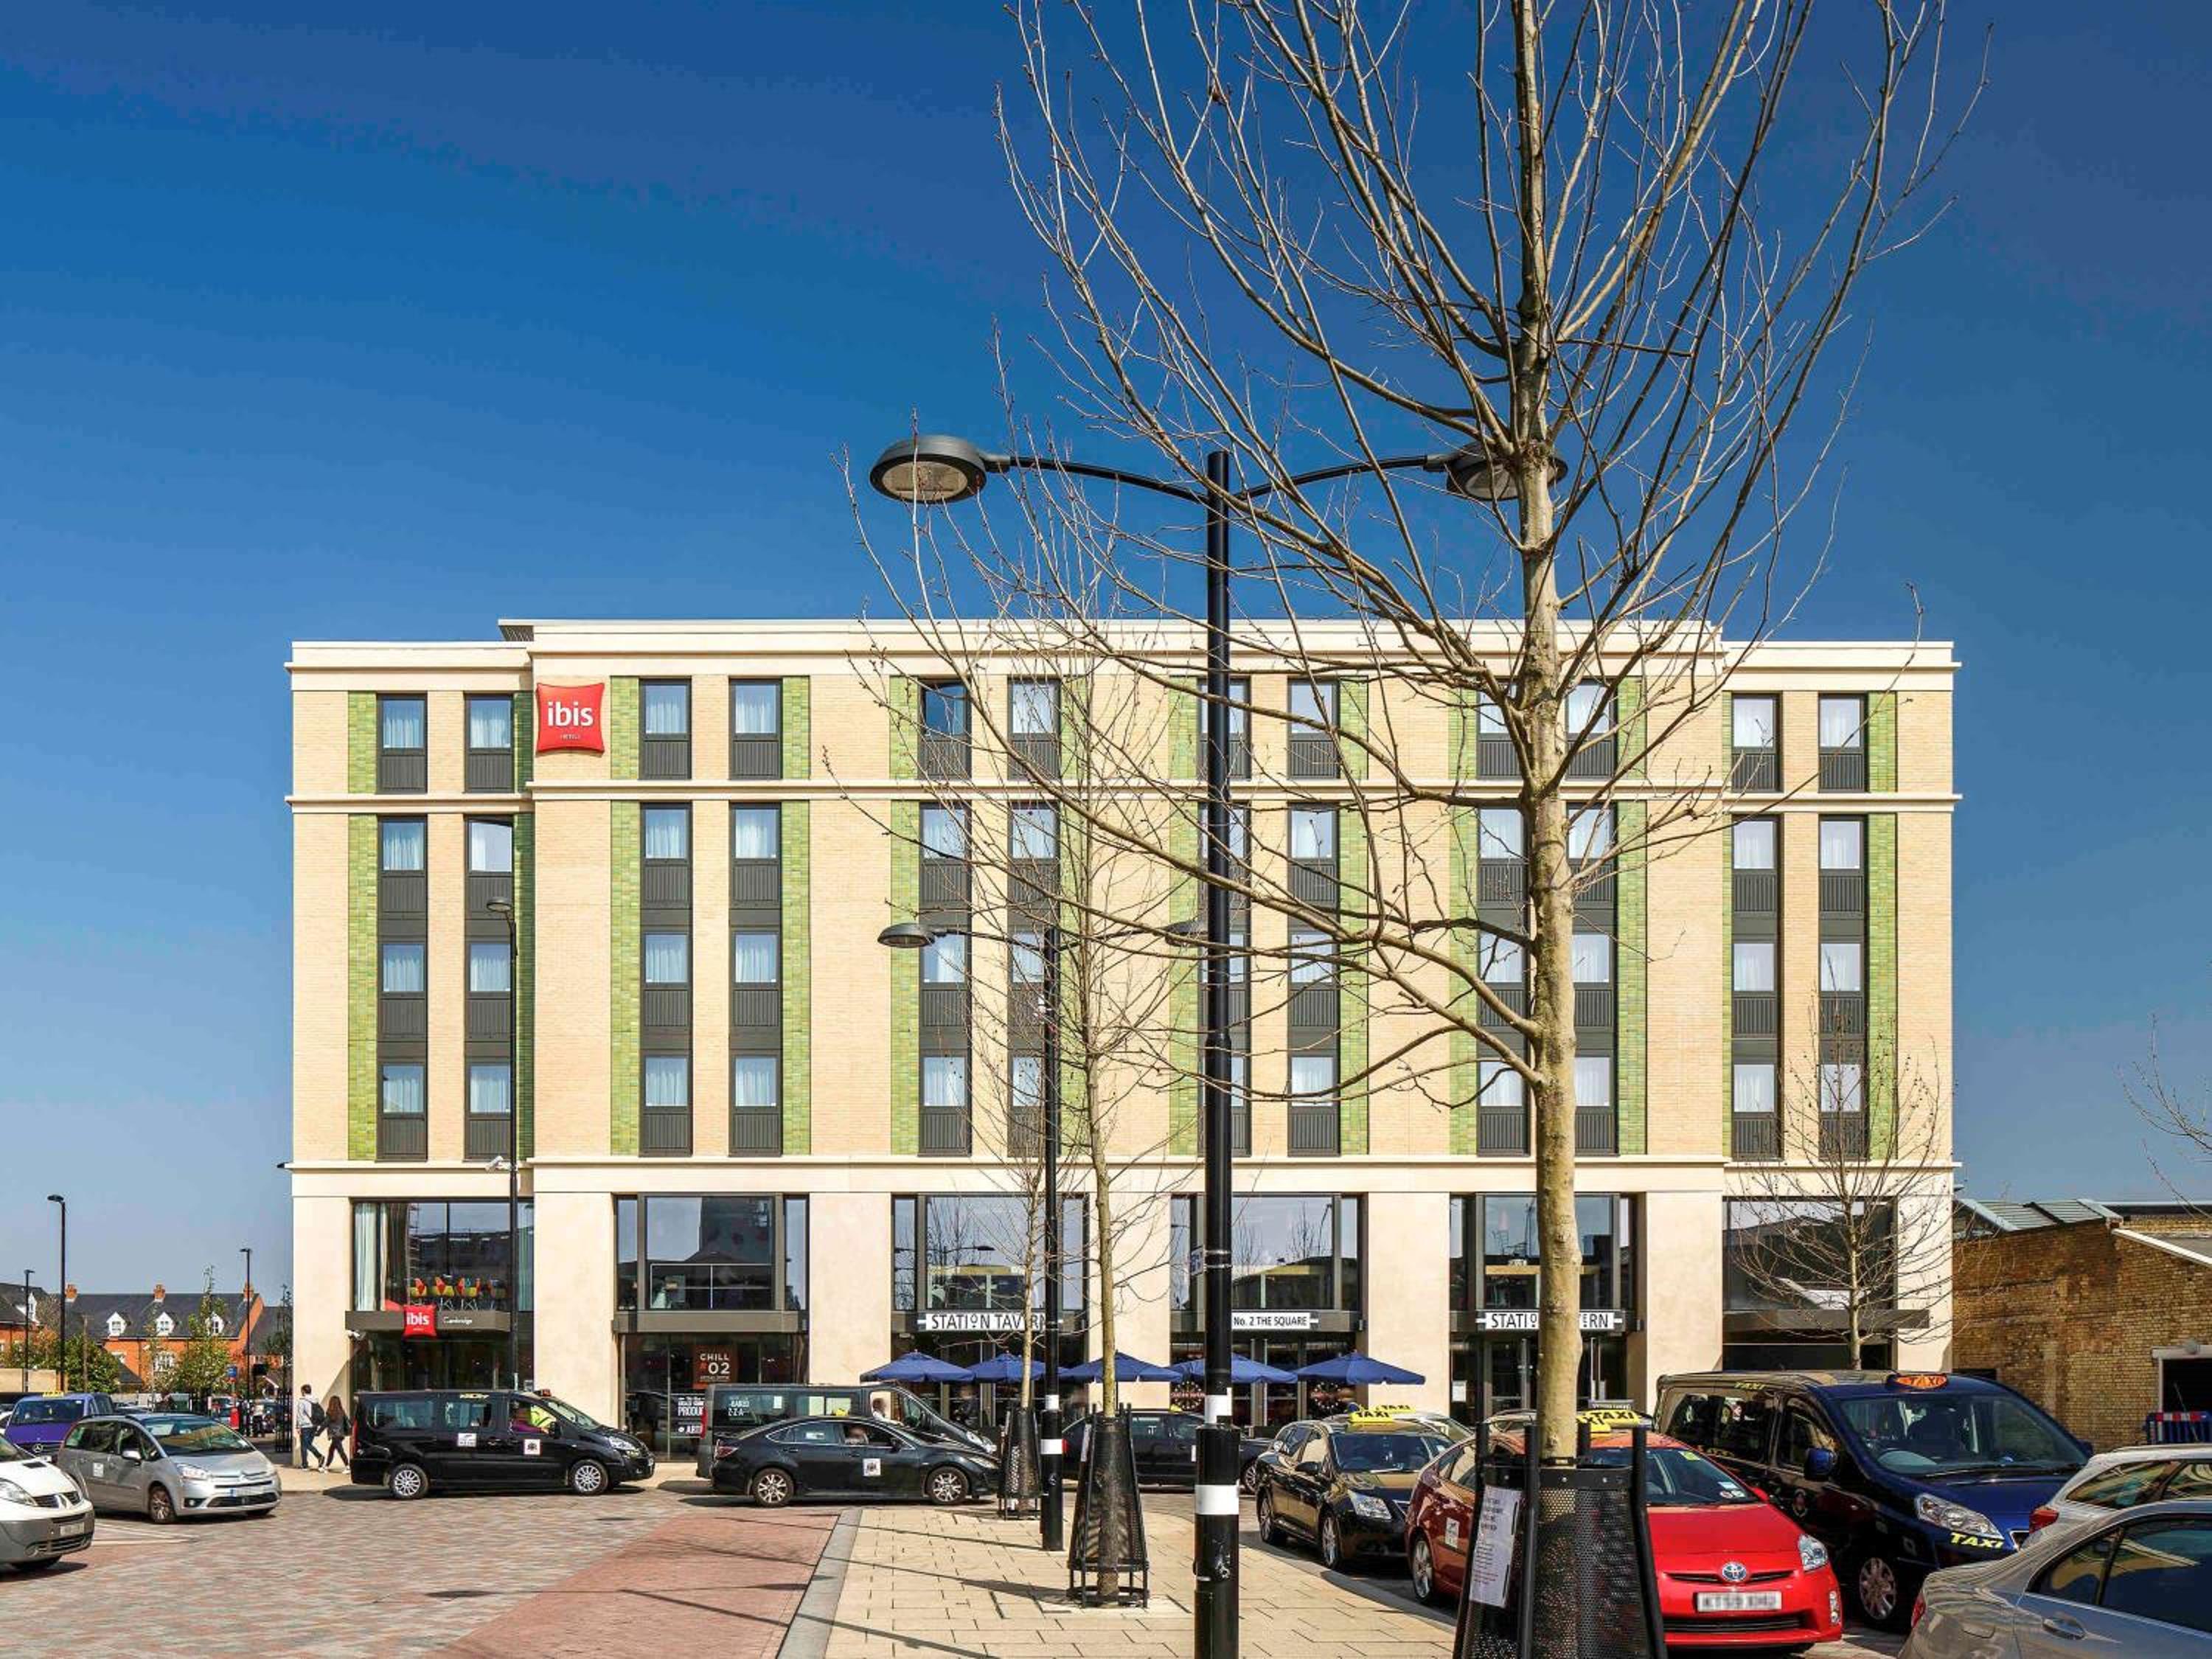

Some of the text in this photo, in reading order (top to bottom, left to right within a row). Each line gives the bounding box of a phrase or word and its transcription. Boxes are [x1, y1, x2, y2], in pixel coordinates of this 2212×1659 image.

[548, 701, 594, 726] ibis
[407, 1312, 429, 1325] ibis
[931, 1315, 990, 1329] STATION
[1234, 1316, 1307, 1326] No. 2 THE SQUARE
[1492, 1313, 1537, 1328] STATIO
[700, 1353, 730, 1361] CHILL
[1590, 1411, 1634, 1419] TAXI
[1950, 1531, 2005, 1548] TAXI
